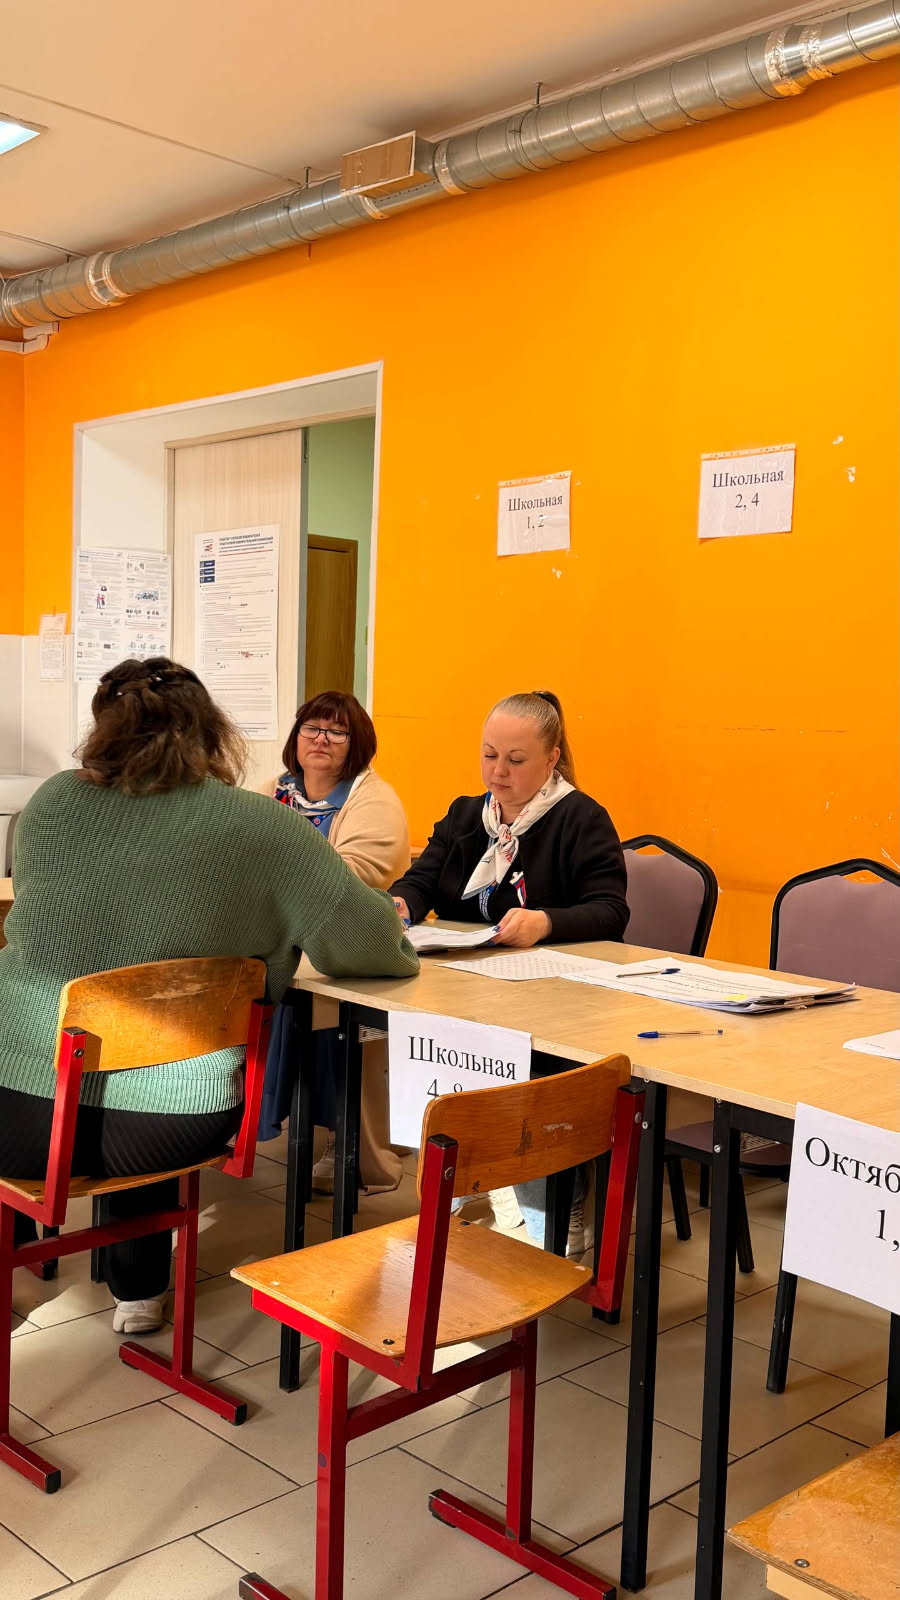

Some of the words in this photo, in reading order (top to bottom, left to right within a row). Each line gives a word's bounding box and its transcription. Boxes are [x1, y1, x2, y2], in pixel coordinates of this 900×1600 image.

[712, 470, 785, 487] Школьная
[508, 495, 563, 511] Школьная
[735, 493, 747, 510] 2,
[751, 492, 760, 506] 4
[527, 516, 535, 531] 1,
[538, 514, 545, 528] 2
[408, 1035, 517, 1081] Школьная
[805, 1136, 900, 1194] Октяб
[874, 1209, 900, 1252] 1,
